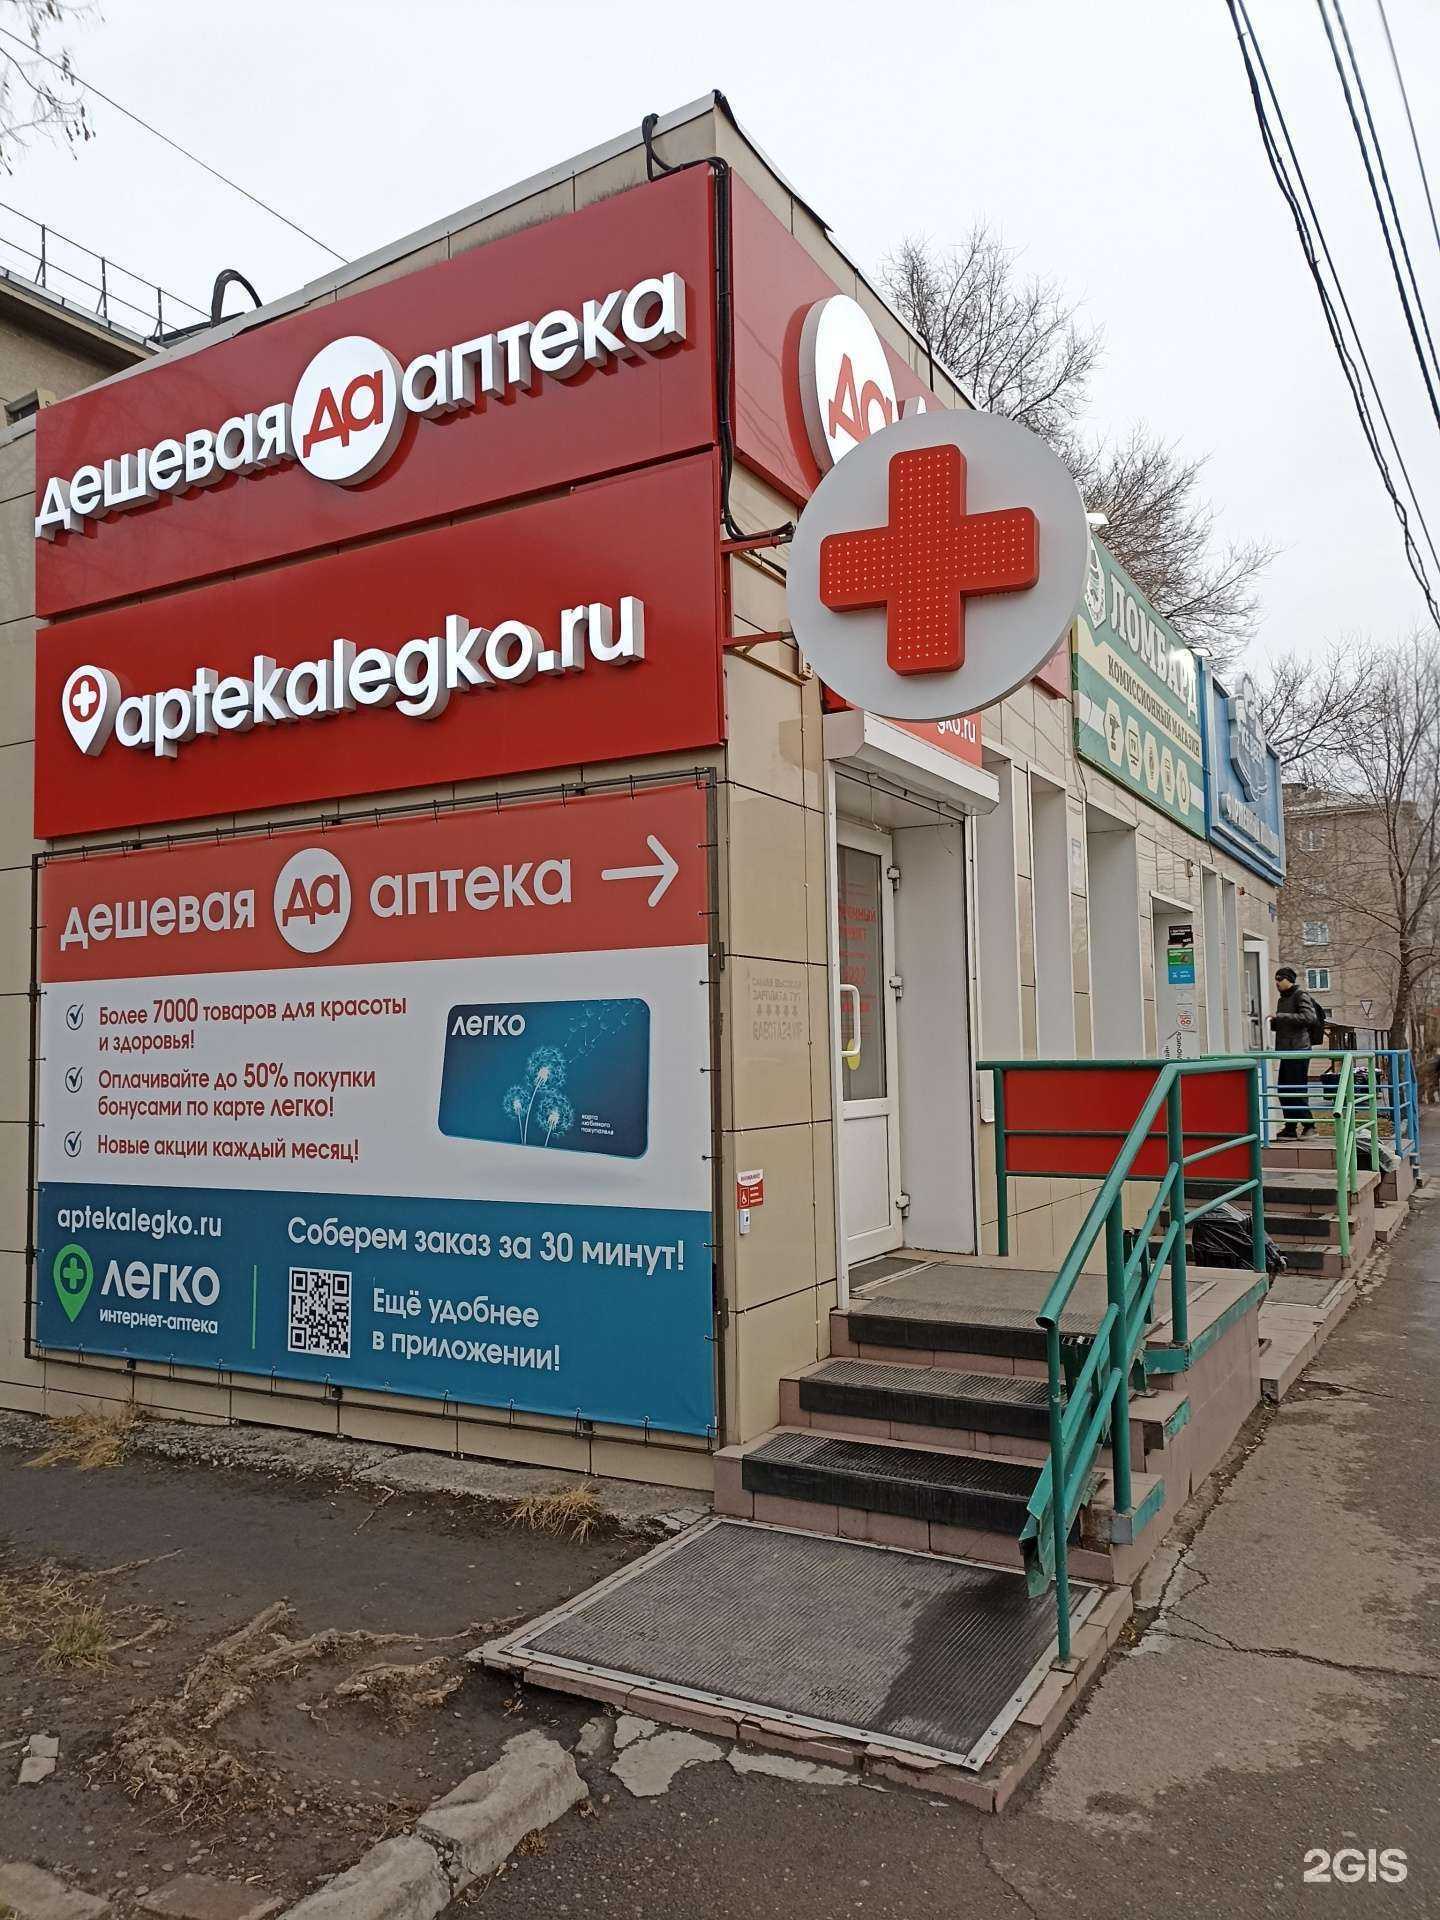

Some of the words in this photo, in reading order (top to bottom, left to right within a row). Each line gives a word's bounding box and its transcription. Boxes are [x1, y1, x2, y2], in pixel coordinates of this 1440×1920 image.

[34, 402, 291, 541] дешевая
[401, 271, 687, 414] аптека
[1109, 574, 1199, 725] ЛОМБАРД
[115, 596, 645, 758] aptekalegko.ru
[1108, 654, 1172, 732] КОМИССИОННЫЙ
[60, 889, 256, 951] дешевая
[370, 857, 573, 919] аптека
[99, 1006, 149, 1026] Более
[153, 998, 199, 1024] 7000
[203, 1001, 277, 1024] товаров
[281, 1001, 315, 1021] для
[320, 996, 407, 1020] красоты
[451, 1012, 527, 1037] легко
[99, 1035, 109, 1051] и
[113, 1030, 195, 1054] здоровья!
[98, 1069, 210, 1090] Оплачивайте
[213, 1070, 237, 1090] до
[243, 1062, 289, 1088] 50%
[294, 1069, 376, 1092] покупки
[98, 1096, 182, 1120] бонусами
[186, 1099, 209, 1117] по
[213, 1098, 265, 1121] карте
[270, 1096, 334, 1118] легко!
[97, 1134, 150, 1156] Новые
[154, 1137, 208, 1158] акции
[212, 1138, 286, 1160] каждый
[291, 1139, 360, 1162] месяц!
[57, 1205, 223, 1240] aptekalegko.ru
[287, 1216, 408, 1254] Соберем
[415, 1230, 492, 1257] заказ
[499, 1236, 532, 1260] за
[540, 1231, 574, 1263] 30
[582, 1240, 685, 1276] минут!
[100, 1259, 222, 1306] легко
[99, 1308, 219, 1335] интернет-аптека
[373, 1288, 422, 1317] Ещё
[429, 1295, 540, 1328] удобнее
[372, 1331, 386, 1351] в
[391, 1333, 560, 1372] приложении!
